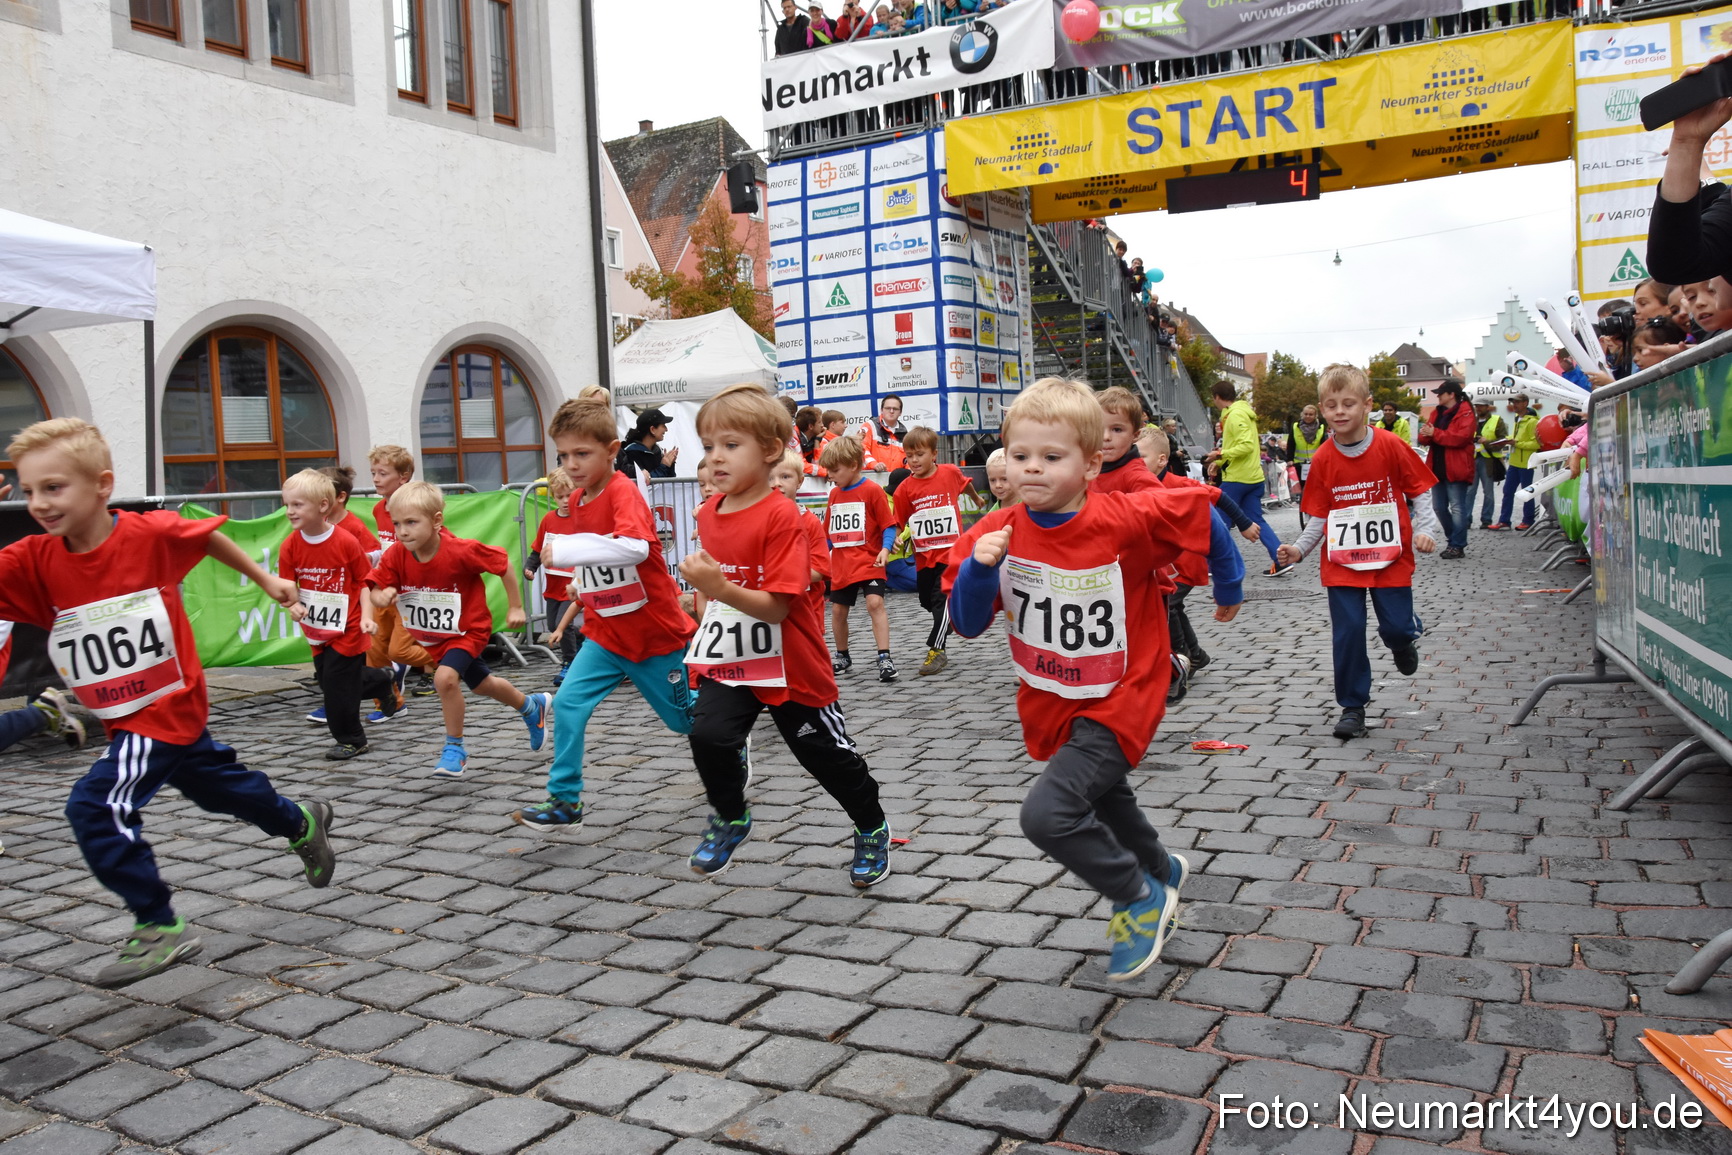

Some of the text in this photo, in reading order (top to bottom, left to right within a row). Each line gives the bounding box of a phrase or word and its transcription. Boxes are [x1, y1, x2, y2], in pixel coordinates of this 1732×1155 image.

[1099, 2, 1180, 28] OCK
[951, 21, 995, 44] BMW
[1117, 31, 1144, 40] smart
[1146, 26, 1187, 37] concepts
[1624, 52, 1666, 65] energie
[762, 46, 931, 112] Neumarkt
[1380, 76, 1532, 109] Neumarkter Stadtlauf
[1127, 77, 1337, 155] START
[974, 140, 1094, 167] Neumarkter Stadtlauf
[1411, 129, 1541, 158] Neumarkter Stadtlauf
[839, 162, 857, 172] CODE
[839, 169, 860, 179] CLINIC
[873, 158, 910, 172] RAIL.ONE
[1582, 157, 1644, 171] RAIL.ONE
[1054, 181, 1158, 201] Neumarkter Stadtlauf
[1290, 168, 1308, 197] 4
[825, 247, 863, 260] VARIOTEC
[813, 335, 851, 346] RAIL.ONE
[815, 371, 849, 386] swn
[887, 379, 928, 389] Lammsbräu
[892, 373, 922, 382] Neumarkter
[1476, 385, 1507, 396] BMW
[1331, 481, 1375, 494] Neumarkter
[1334, 491, 1367, 502] Stadtlauf
[1359, 506, 1393, 515] BOCK
[913, 516, 953, 537] 7057
[1335, 519, 1395, 547] 7160
[1637, 496, 1721, 558] Mehr Sicherheit
[1351, 551, 1381, 562] Moritz
[1006, 570, 1044, 585] NeuerMarkt
[1049, 570, 1112, 591] BOCK
[1637, 553, 1706, 625] für Ihr Event!
[86, 594, 151, 622] BOCK
[593, 592, 623, 607] Philipp
[405, 604, 455, 631] 7033
[1011, 587, 1115, 652] 7183
[58, 618, 165, 680] 7064
[1116, 640, 1122, 649] K
[707, 666, 745, 680] Eliah
[1035, 655, 1081, 682] Adam
[1638, 635, 1729, 721] Miet & Service Line: 09181
[94, 678, 147, 703] Moritz
